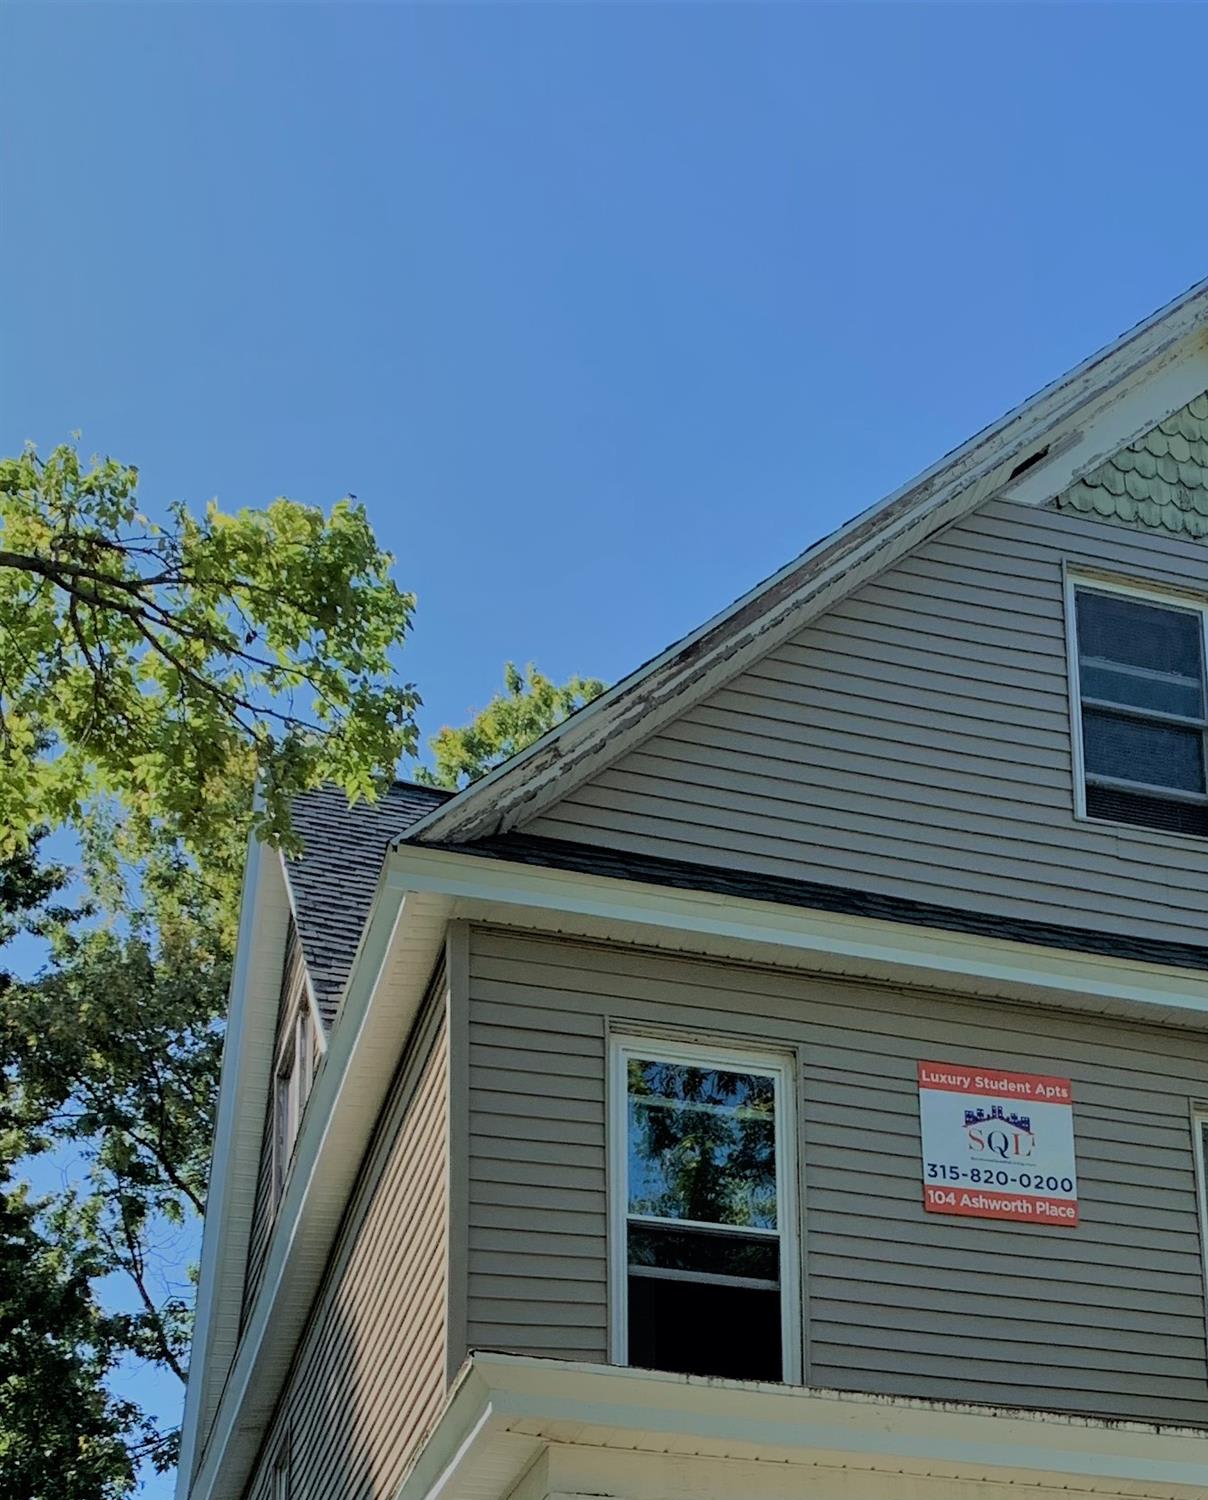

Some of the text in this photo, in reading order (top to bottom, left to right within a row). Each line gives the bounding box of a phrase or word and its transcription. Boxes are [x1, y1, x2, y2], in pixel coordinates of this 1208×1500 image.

[922, 1069, 1069, 1098] Luxury Student Apts
[927, 1163, 1073, 1193] 315-820-0200
[928, 1190, 1075, 1218] 104 Ashworth Place
